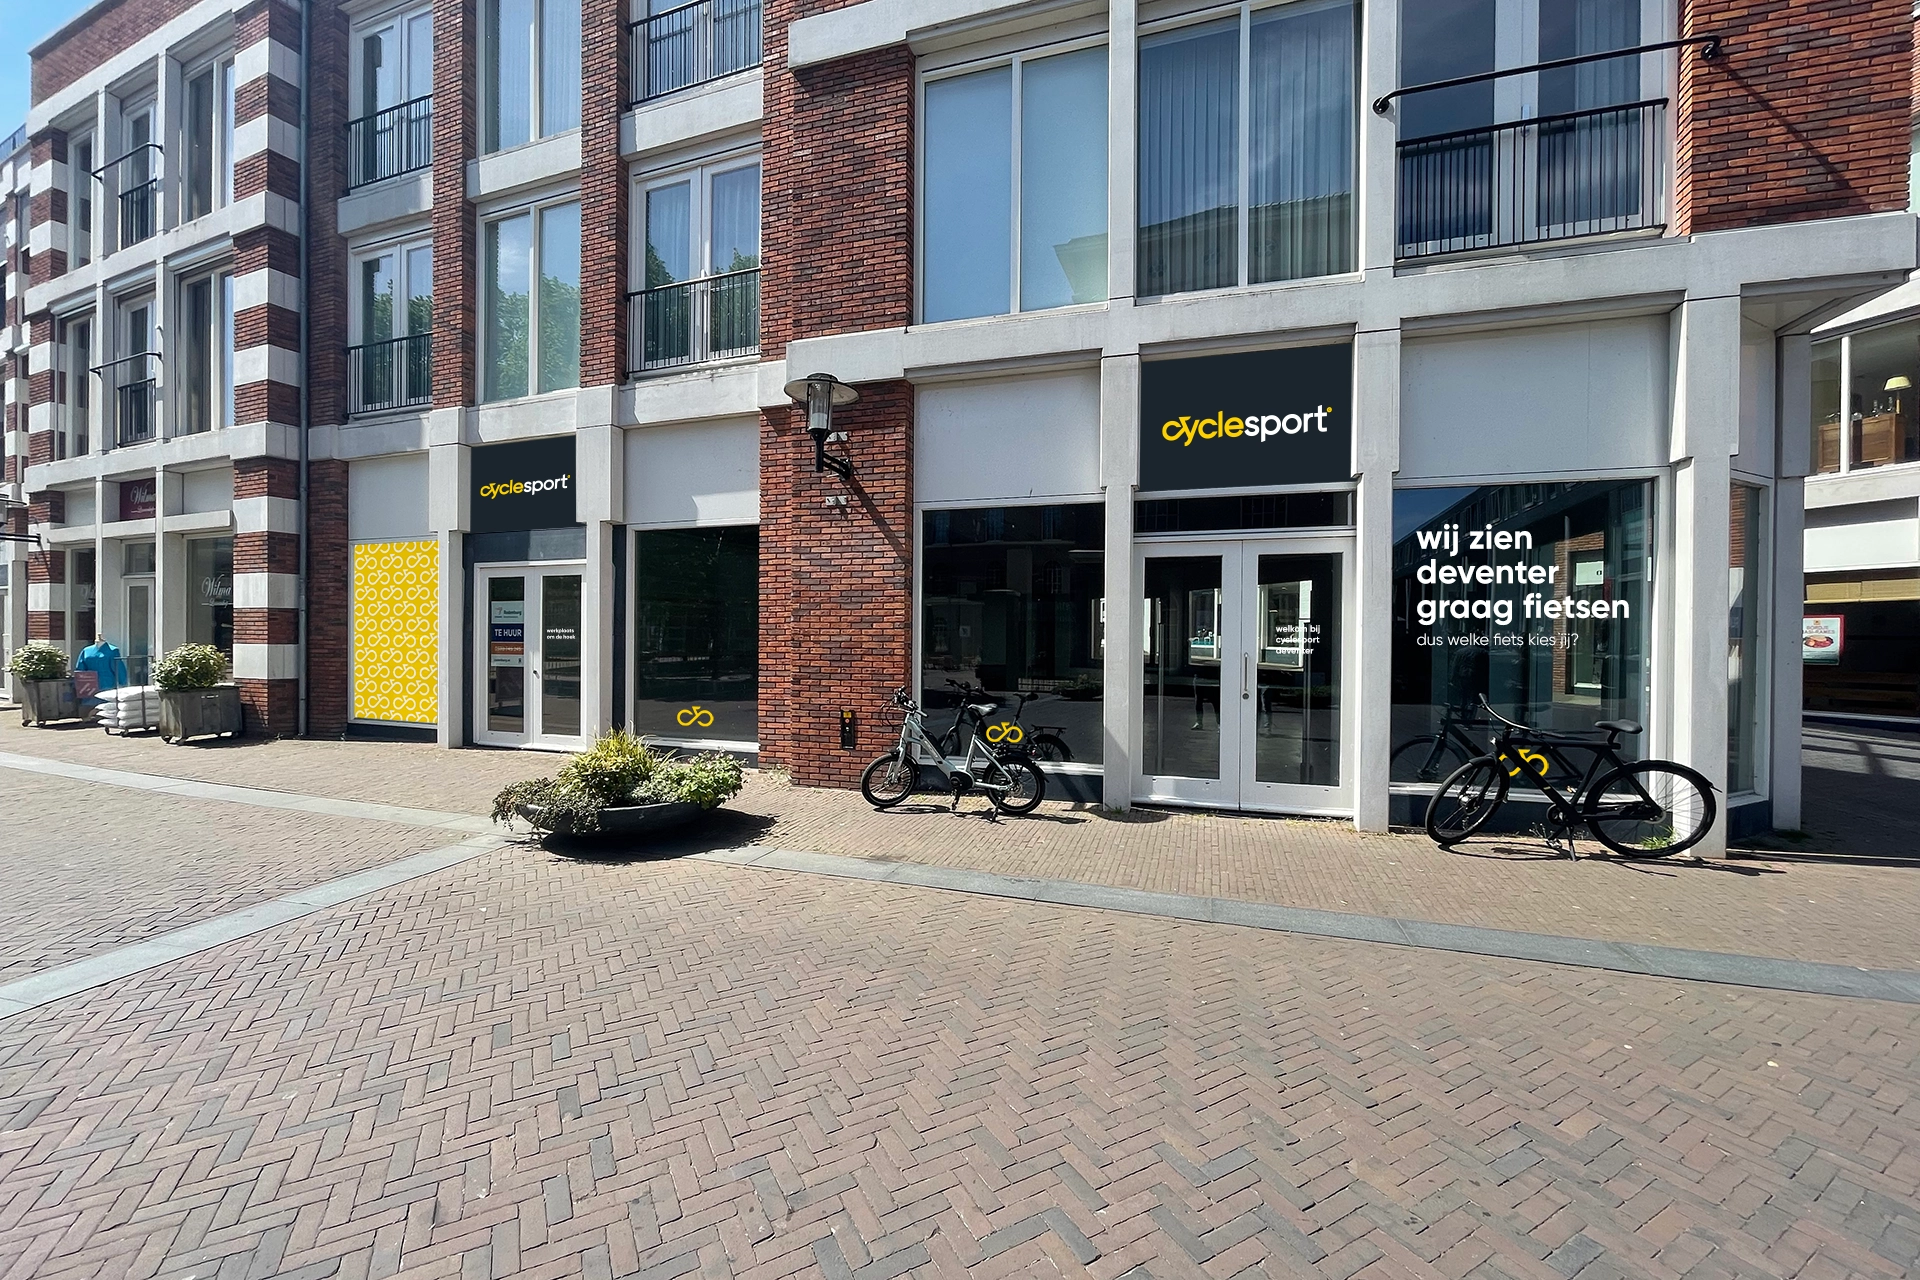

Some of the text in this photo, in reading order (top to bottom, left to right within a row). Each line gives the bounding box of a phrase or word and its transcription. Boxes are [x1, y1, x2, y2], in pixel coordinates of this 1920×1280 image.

[1161, 404, 1329, 447] cyclesport
[480, 474, 569, 499] cyclesport
[1416, 523, 1533, 557] wij zien
[1416, 558, 1560, 585] deventer
[1416, 592, 1630, 626] graag fietsen
[494, 628, 522, 637] TE HUUR
[1310, 624, 1321, 635] bij
[1416, 632, 1580, 650] dus welke fiets kies jij?
